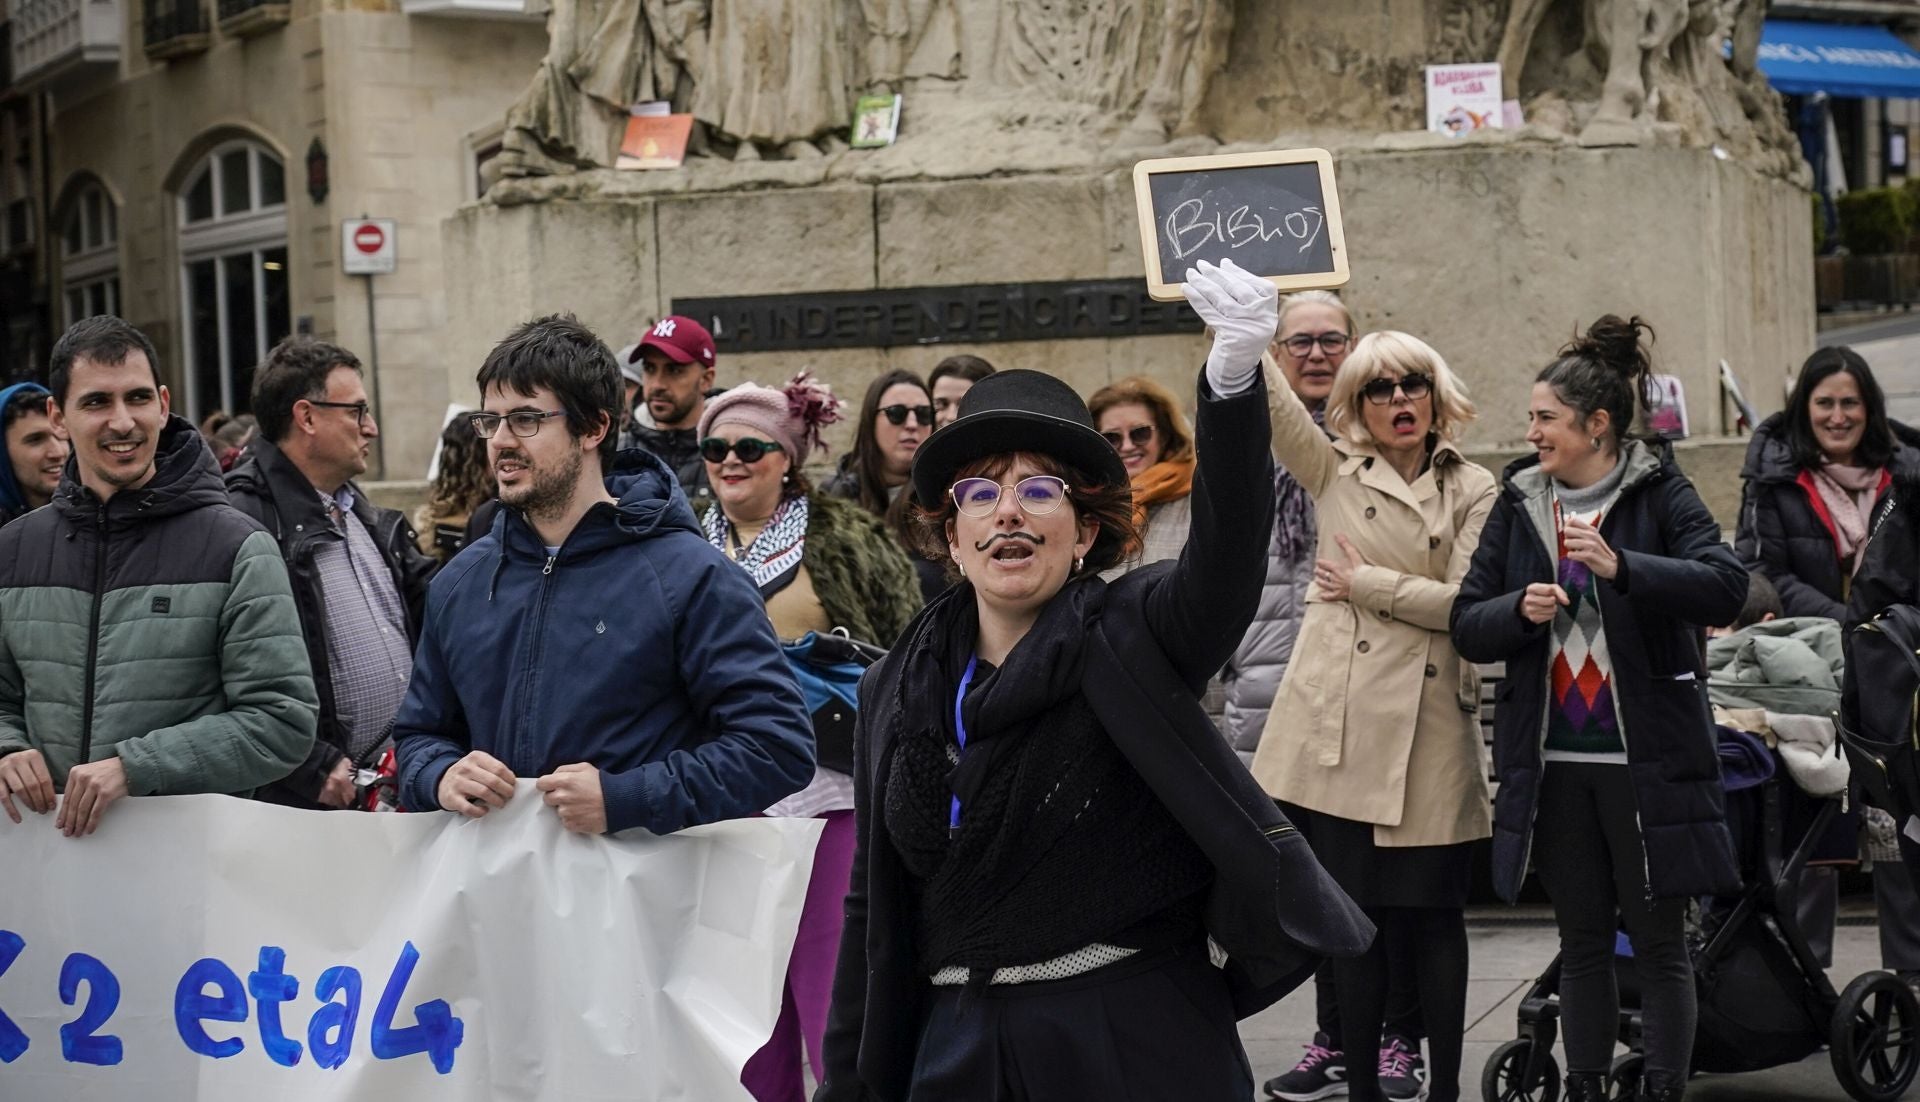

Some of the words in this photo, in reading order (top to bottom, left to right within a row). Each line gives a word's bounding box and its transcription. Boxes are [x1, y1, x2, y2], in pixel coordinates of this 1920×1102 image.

[710, 310, 755, 343] LA
[769, 294, 1096, 340] INDEPENDENCIA
[1108, 293, 1163, 326] DE
